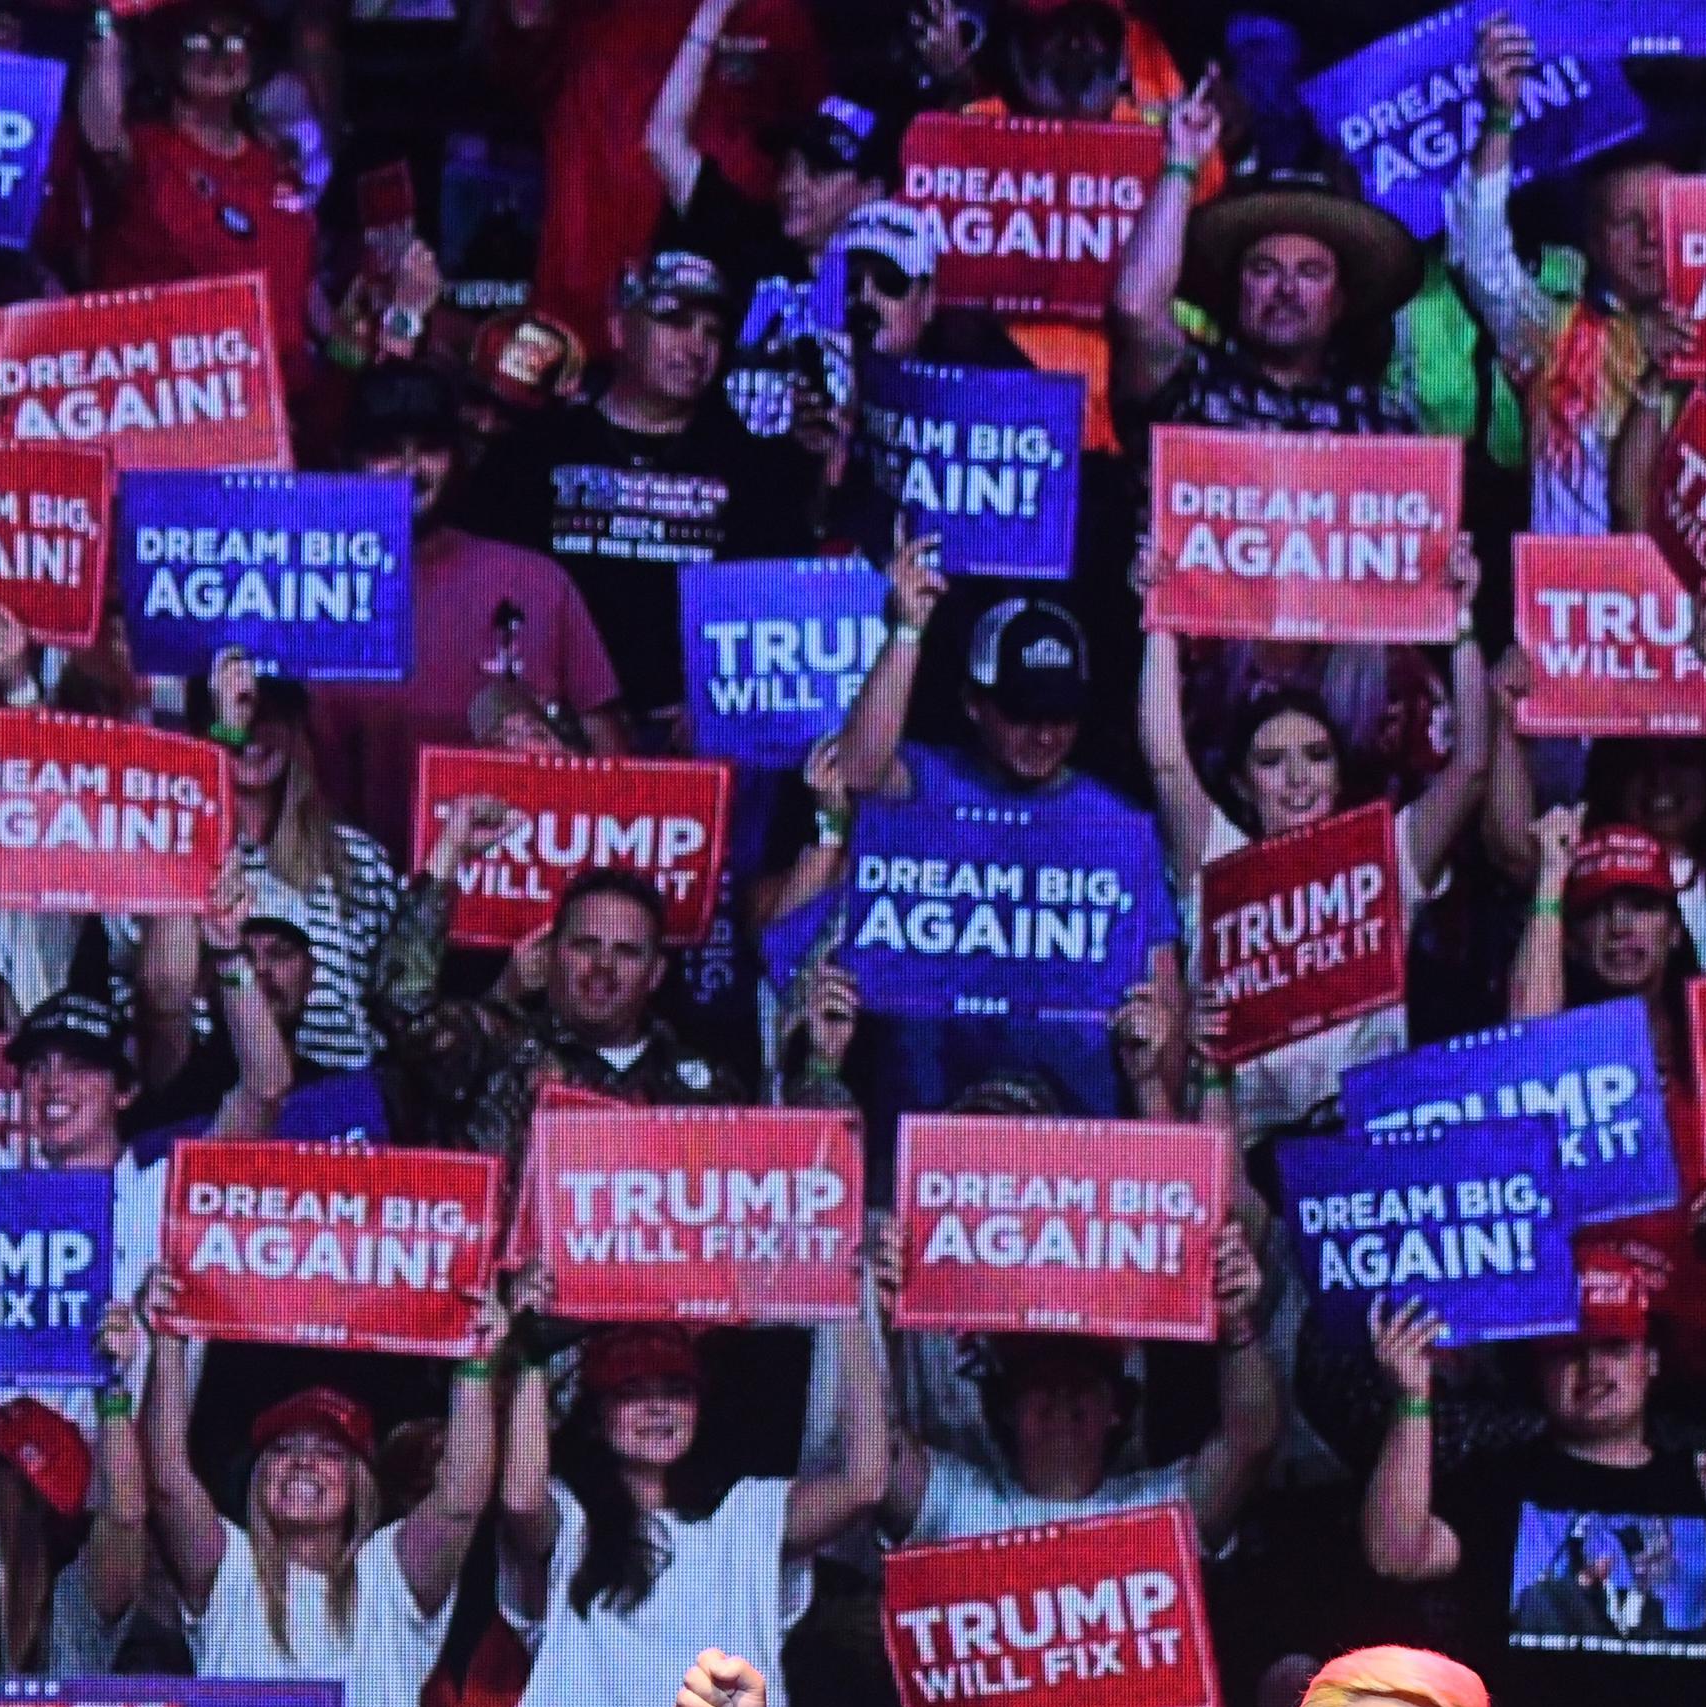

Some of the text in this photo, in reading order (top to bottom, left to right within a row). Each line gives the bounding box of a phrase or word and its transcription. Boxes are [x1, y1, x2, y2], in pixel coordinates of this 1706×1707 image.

[906, 165, 1054, 203] DREAM
[15, 372, 246, 440] AGAIN!
[1172, 483, 1335, 523] DREAM
[138, 528, 287, 566] DREAM
[1176, 522, 1420, 581] AGAIN!
[144, 569, 372, 622] AGAIN!
[858, 856, 1023, 899] DREAM
[856, 895, 1109, 962] AGAIN!
[1213, 864, 1383, 968] TRUMP
[1214, 918, 1385, 1005] WILL FIX IT
[189, 1184, 366, 1228] DREAM
[559, 1167, 847, 1227] TRUMP
[917, 1171, 1095, 1213] DREAM
[1298, 1185, 1446, 1234] DREAM
[190, 1222, 455, 1293] AGAIN!
[562, 1227, 842, 1264] WILL FIX IT
[924, 1215, 1182, 1275] AGAIN!
[1321, 1219, 1537, 1290] AGAIN!
[48, 1290, 90, 1327] IT
[896, 1570, 1178, 1666] TRUMP
[910, 1627, 1182, 1703] WILL FIX IT
